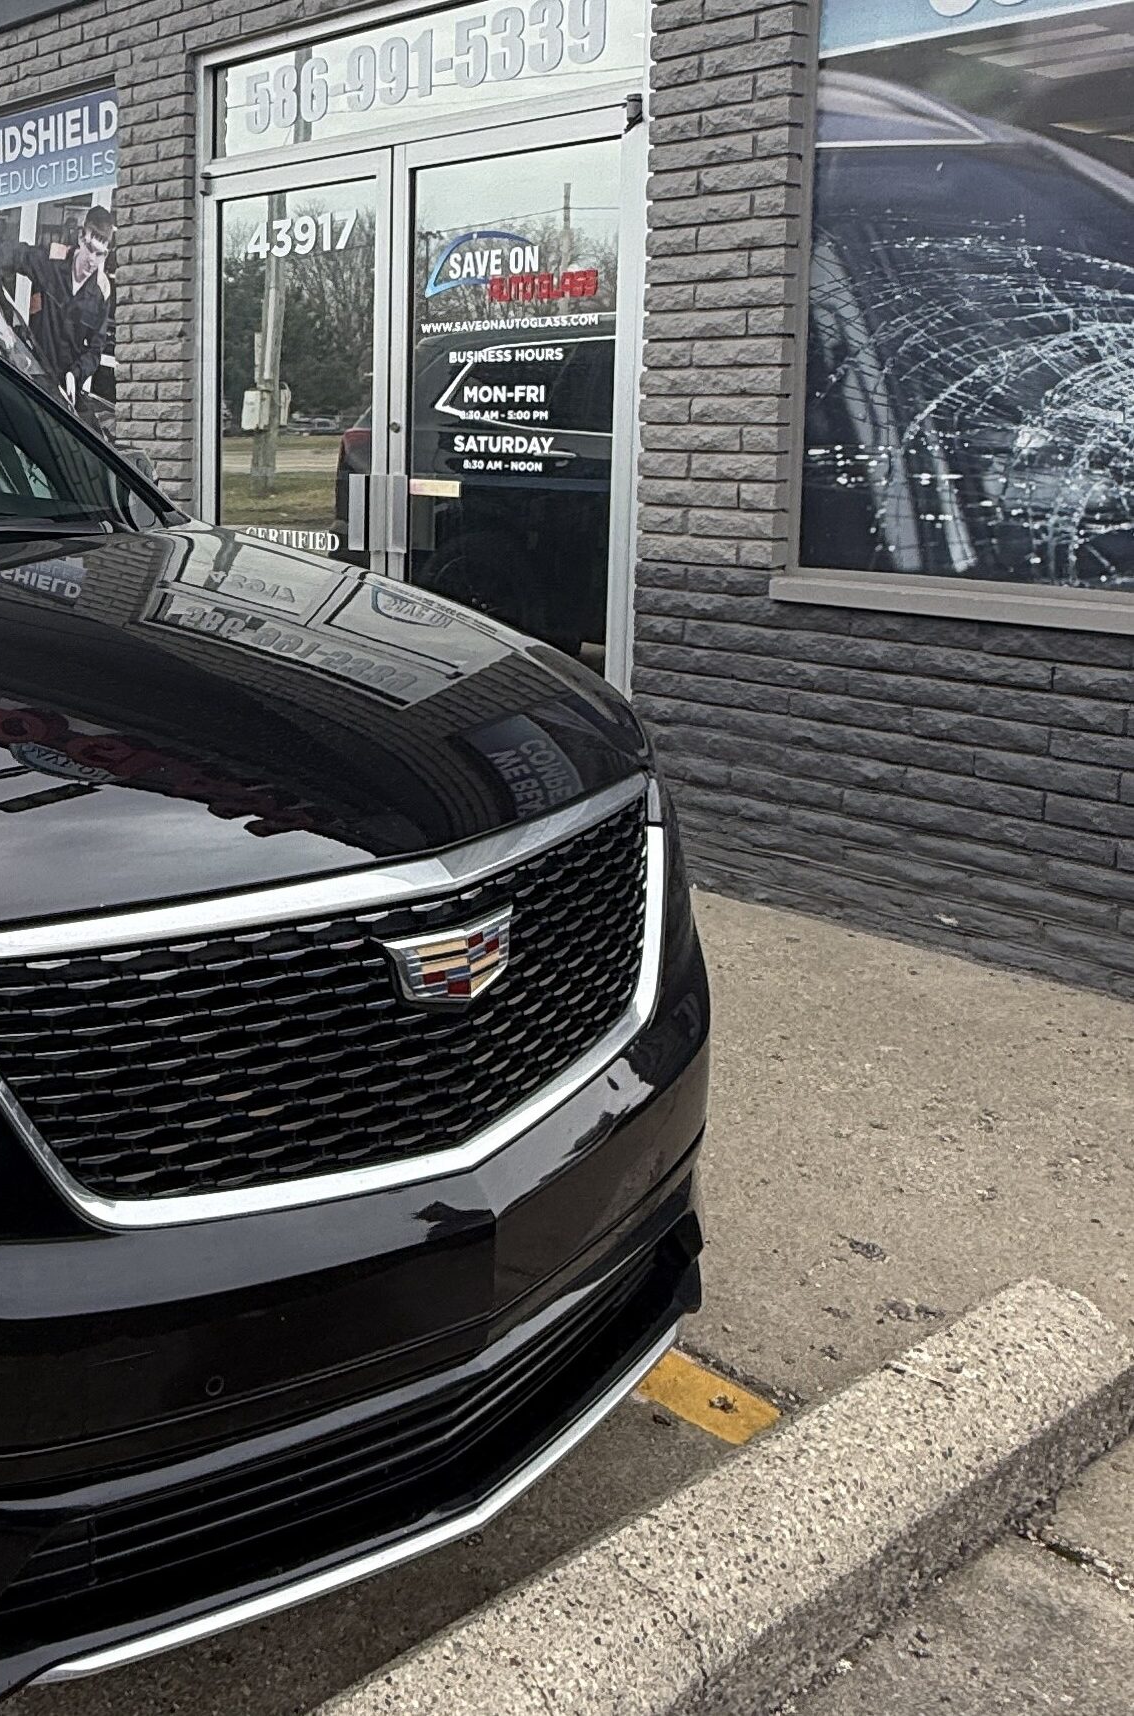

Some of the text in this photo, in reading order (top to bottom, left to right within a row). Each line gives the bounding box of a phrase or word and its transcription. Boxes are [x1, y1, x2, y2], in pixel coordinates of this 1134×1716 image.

[245, 0, 607, 134] 586-991-5339
[246, 208, 359, 260] 43917
[449, 245, 540, 280] SAVE ON
[421, 314, 598, 333] WWW.SAVEONAUTOGLASS.COM
[448, 347, 564, 363] BUSINESS HOURS
[463, 384, 546, 403] MON-FRI
[482, 410, 499, 420] AM
[506, 410, 531, 420] 5:00
[532, 410, 549, 420] PM
[453, 434, 554, 453] SATURDAY
[485, 460, 503, 470] AM
[510, 460, 543, 472] NOON
